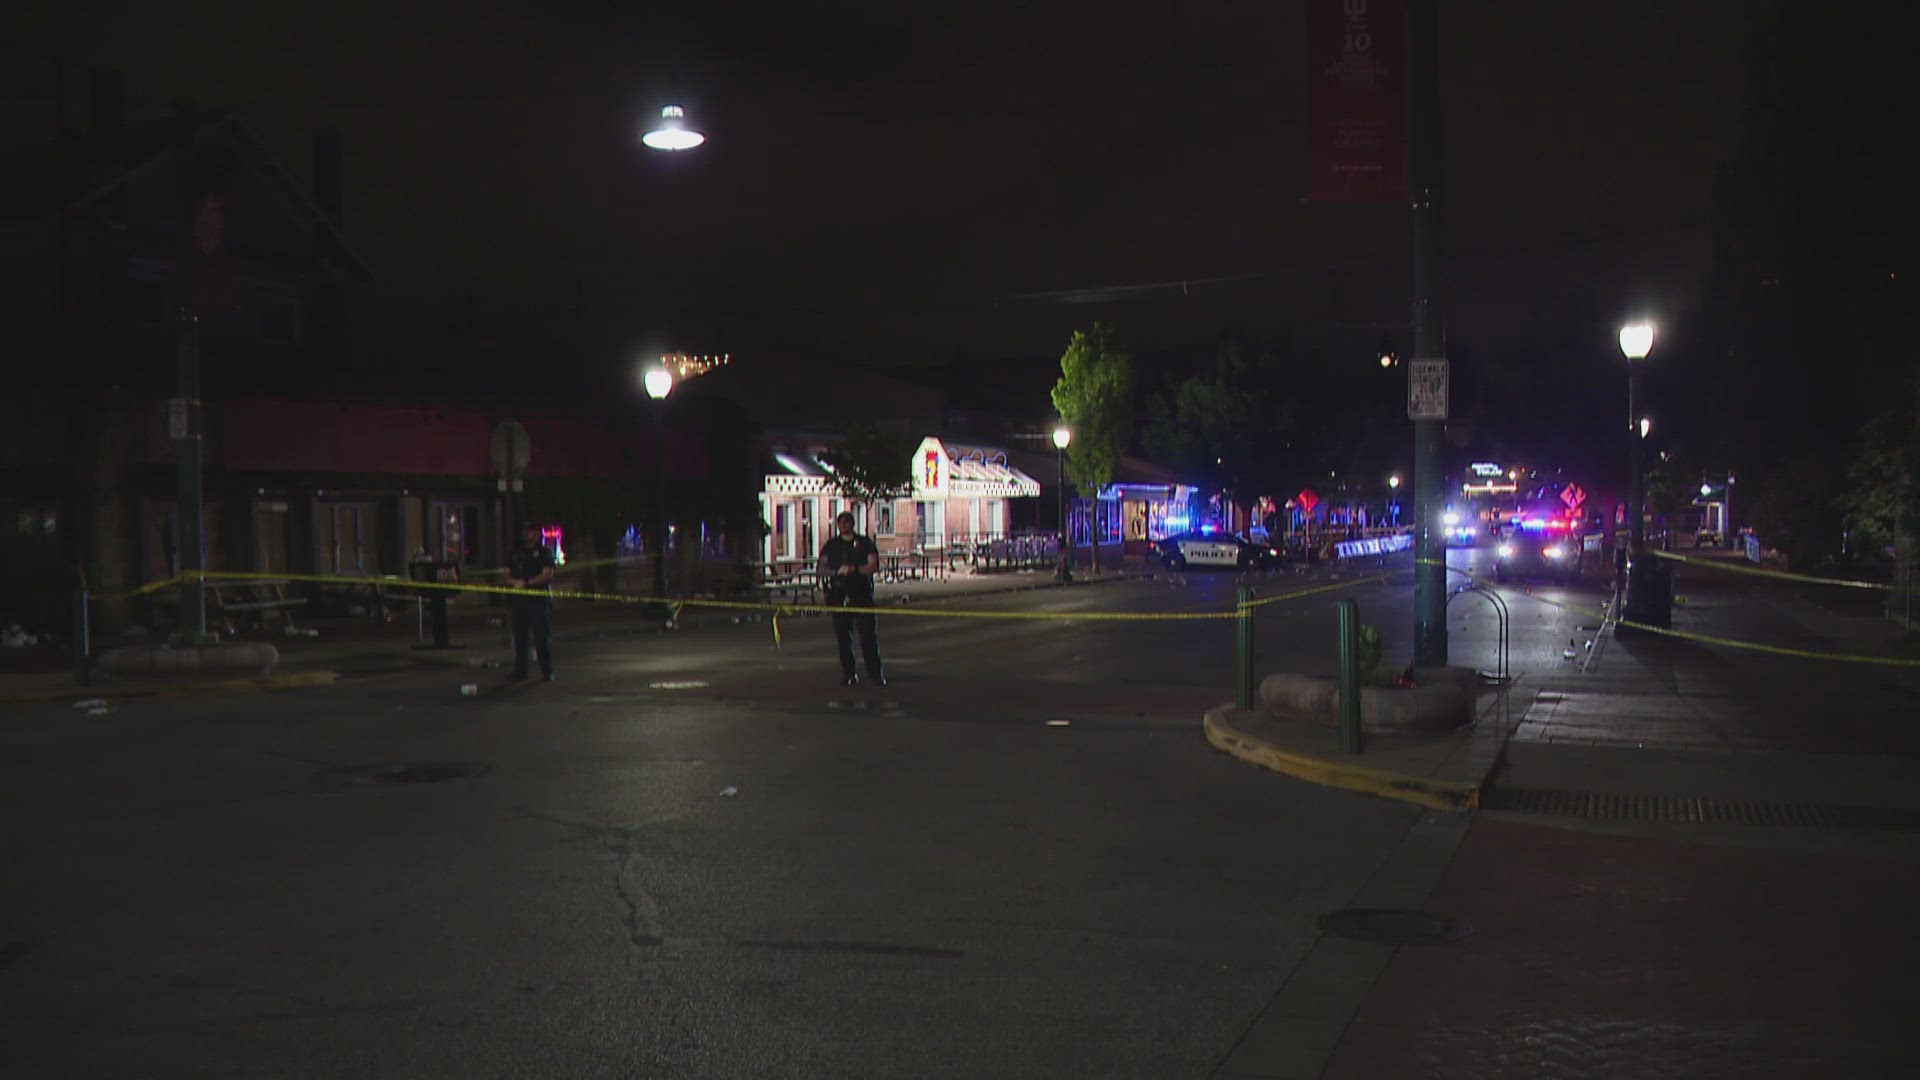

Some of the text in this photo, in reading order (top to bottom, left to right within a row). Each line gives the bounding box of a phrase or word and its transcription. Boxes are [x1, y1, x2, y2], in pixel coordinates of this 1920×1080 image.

[1343, 33, 1372, 53] 10
[1411, 364, 1445, 374] SIDEWALK
[1190, 550, 1228, 559] POLICE
